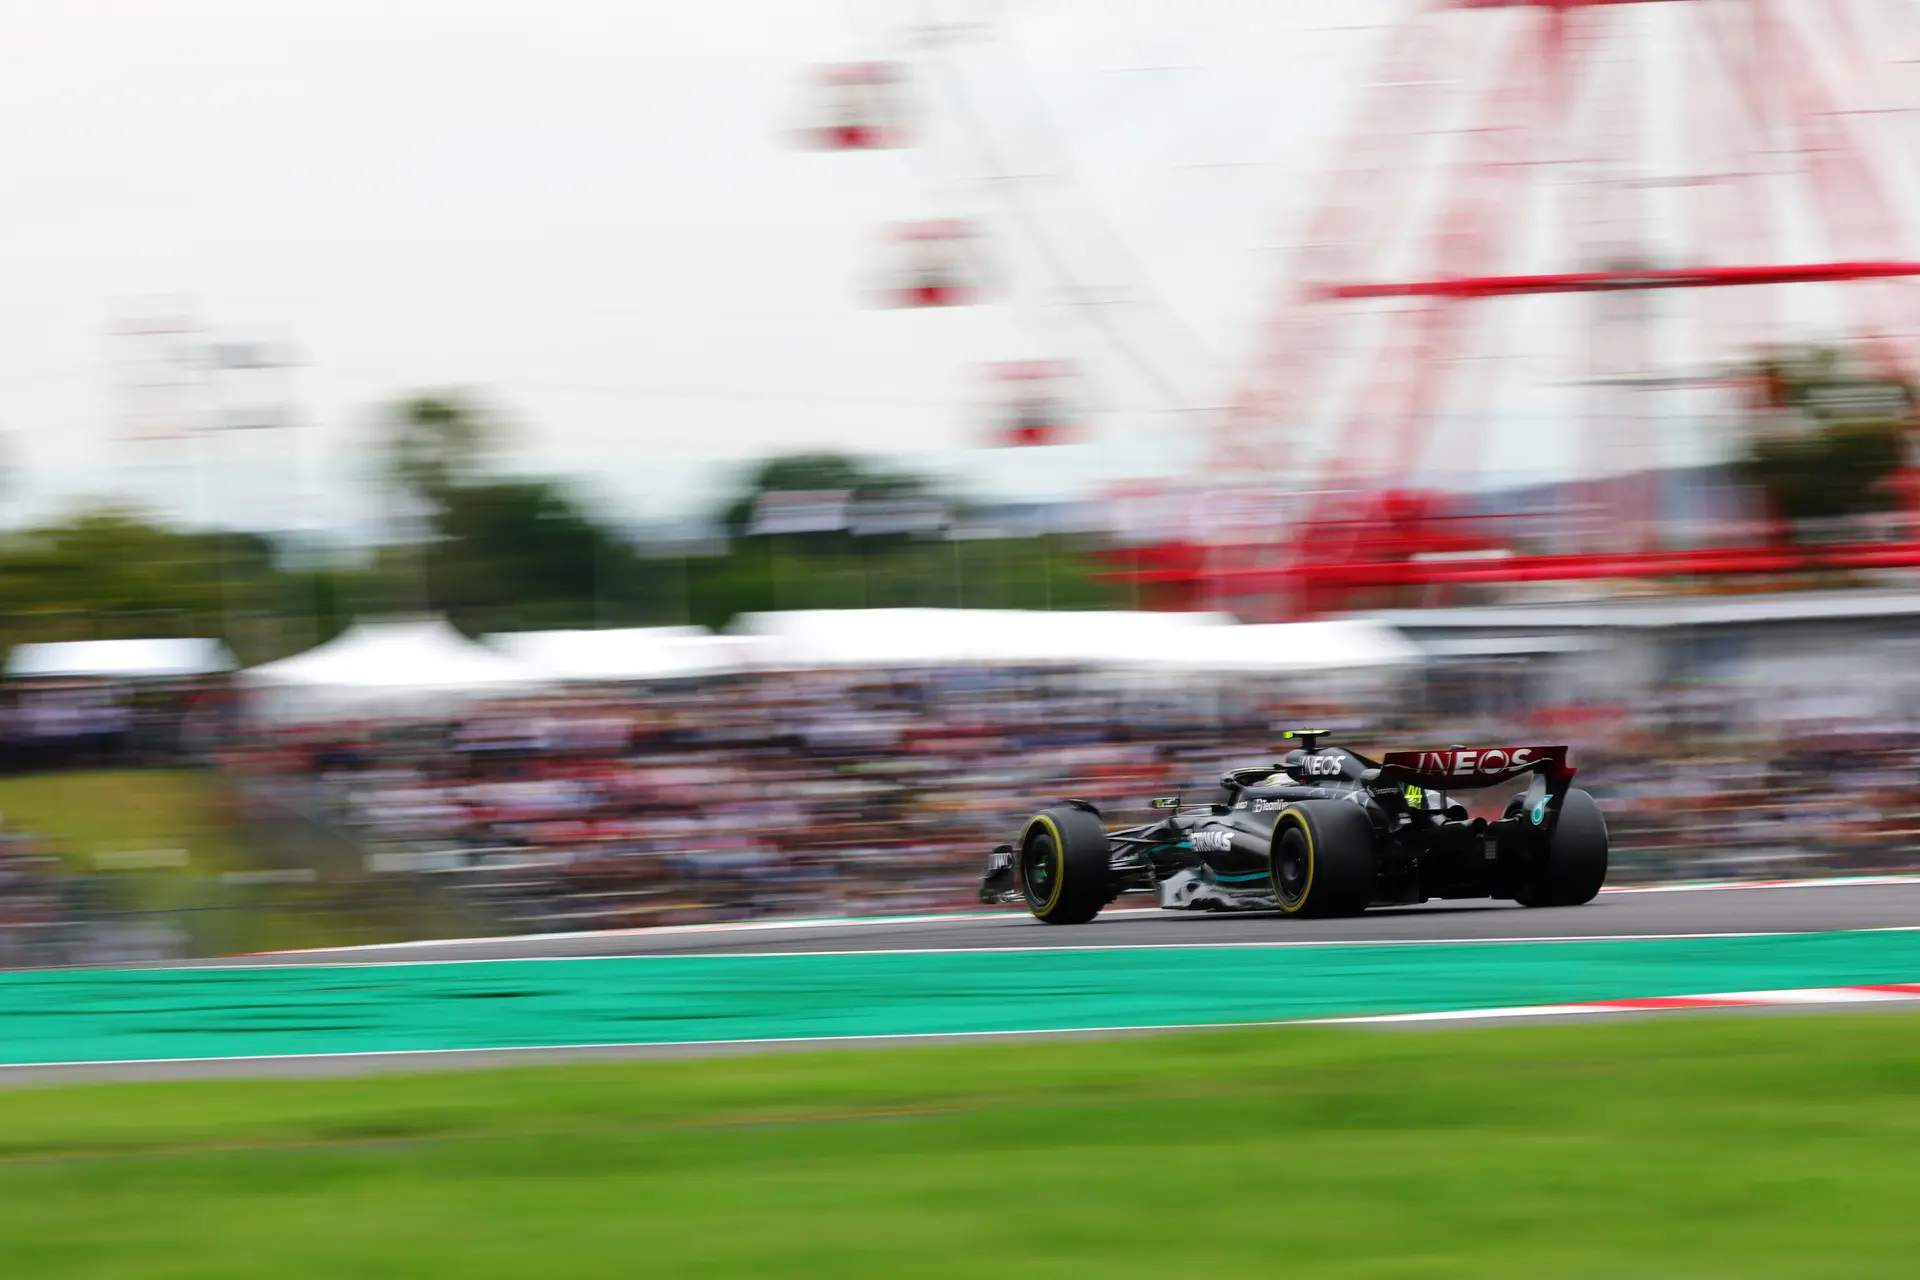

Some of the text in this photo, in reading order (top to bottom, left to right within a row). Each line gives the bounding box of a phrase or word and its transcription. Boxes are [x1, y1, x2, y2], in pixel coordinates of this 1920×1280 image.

[1300, 755, 1346, 775] INEOS
[1416, 749, 1532, 776] INEOS
[1404, 785, 1423, 803] 44
[1262, 799, 1297, 811] TeamVie
